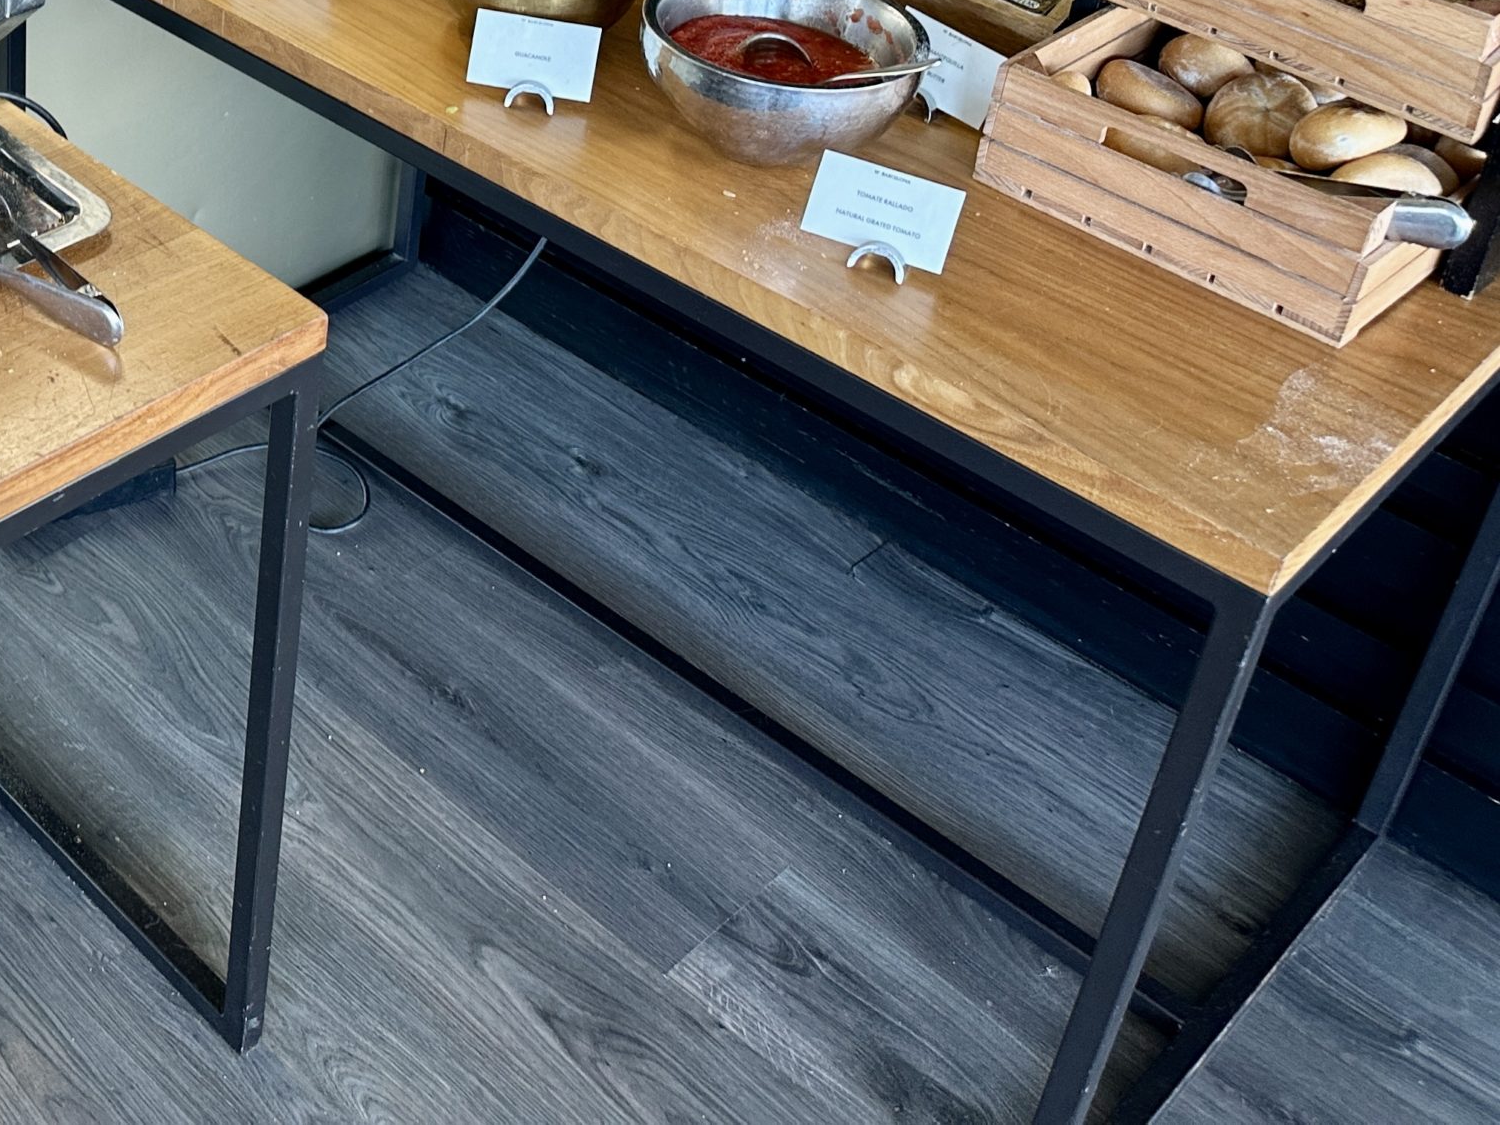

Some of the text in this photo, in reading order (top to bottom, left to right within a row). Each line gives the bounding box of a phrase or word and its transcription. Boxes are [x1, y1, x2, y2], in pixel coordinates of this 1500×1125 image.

[514, 50, 552, 63] GUACAMOLE
[857, 189, 914, 213] TOMATE RALLADO
[835, 207, 921, 240] NATURAL GRATED TOMATO
